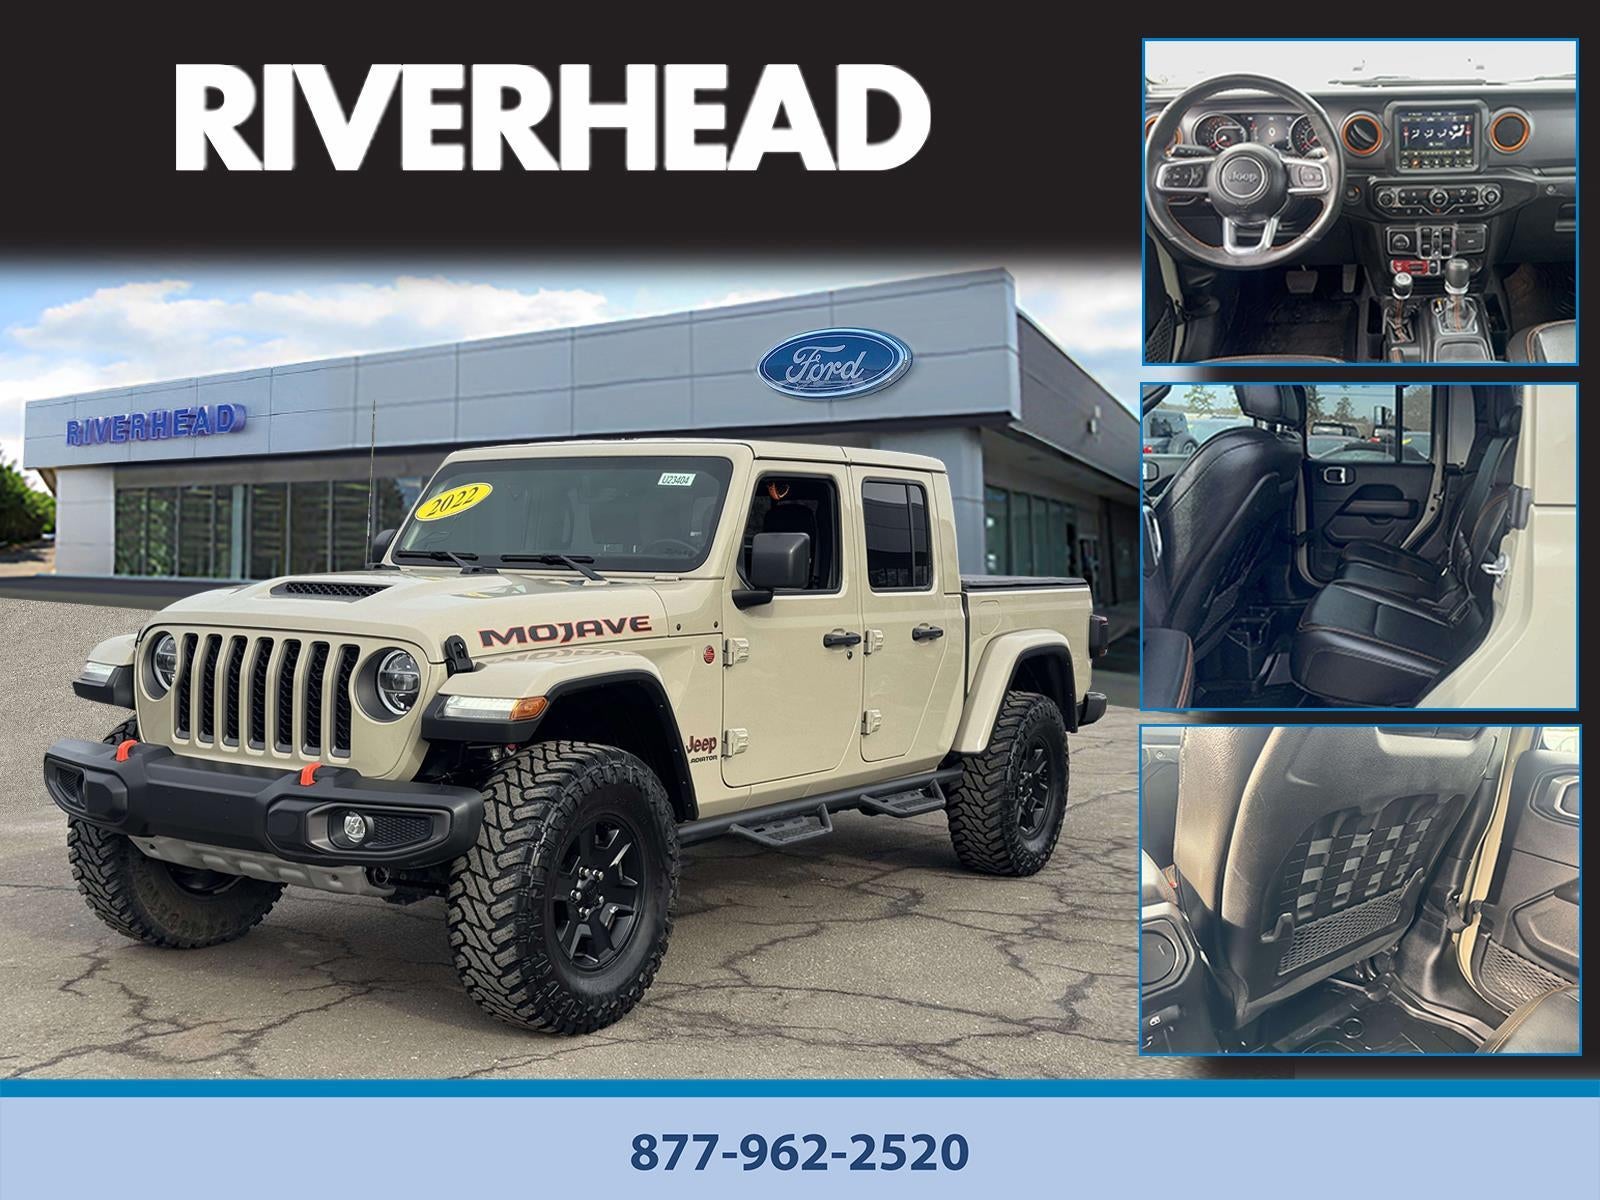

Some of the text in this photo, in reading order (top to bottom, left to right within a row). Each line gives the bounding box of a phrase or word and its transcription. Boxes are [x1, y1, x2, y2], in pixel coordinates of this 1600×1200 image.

[786, 344, 867, 384] Ford
[66, 403, 243, 447] RIVERHEAD
[426, 486, 479, 517] 2022
[478, 615, 653, 648] MOJAVE
[686, 735, 717, 755] Jeep
